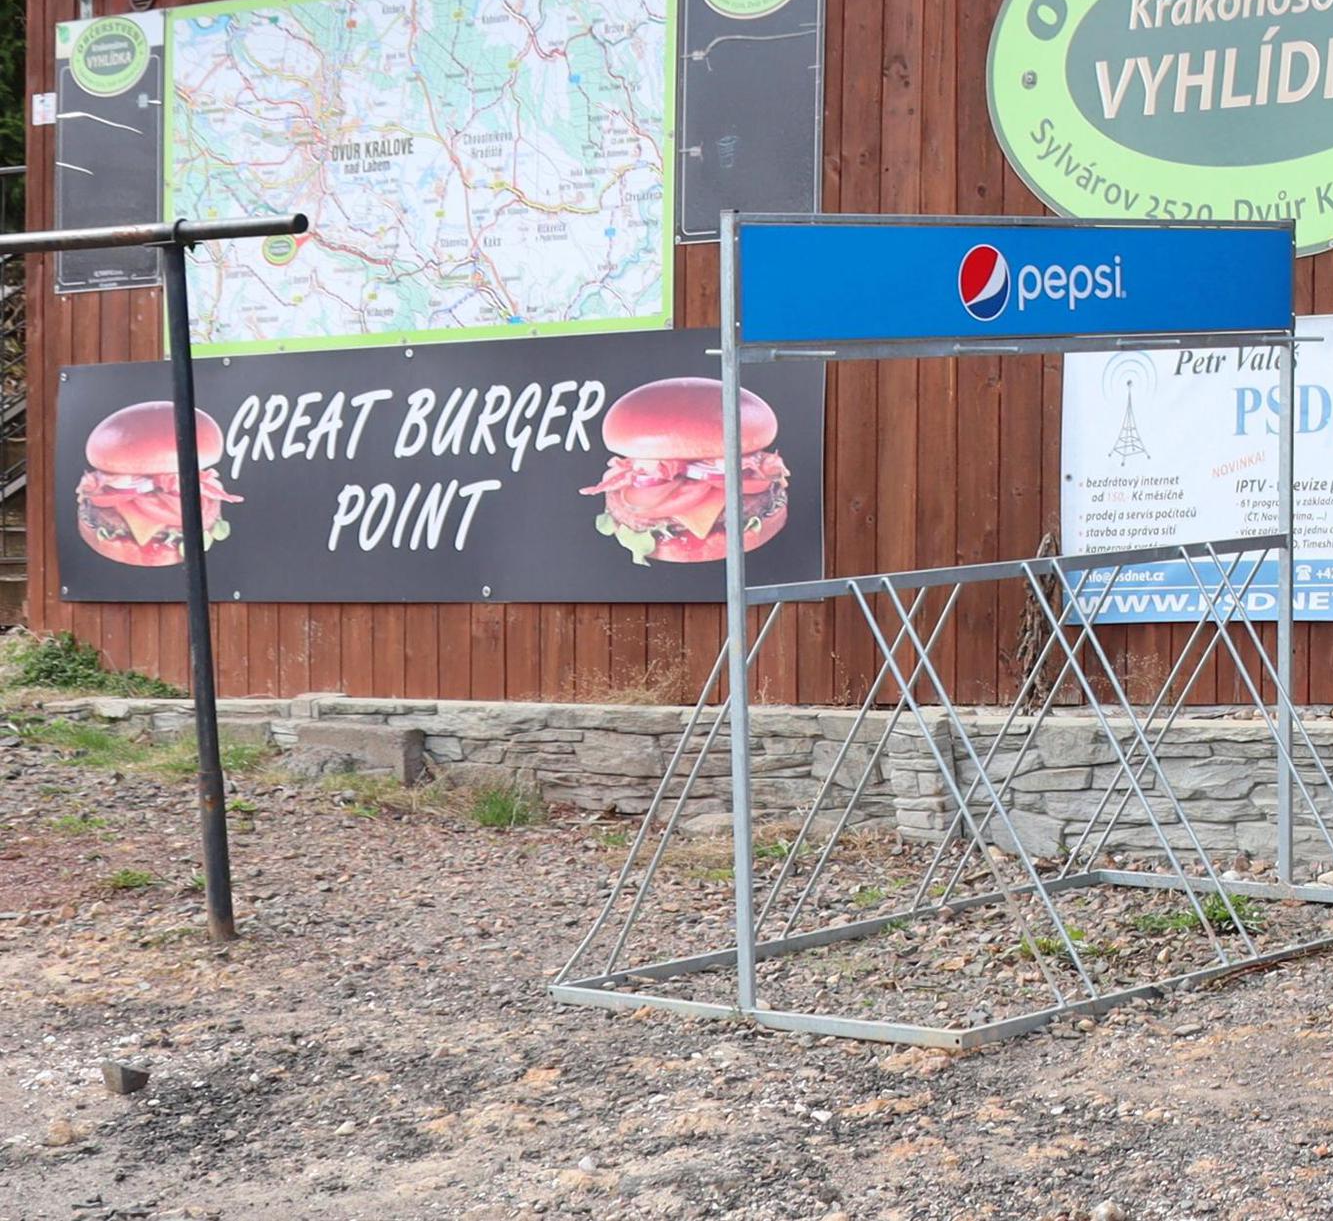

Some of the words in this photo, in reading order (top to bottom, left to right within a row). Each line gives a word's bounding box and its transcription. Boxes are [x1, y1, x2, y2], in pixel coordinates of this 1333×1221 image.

[1030, 118, 1139, 212] Sylvárov
[1234, 191, 1305, 220] Dvůr
[1018, 255, 1124, 311] pepsi
[1174, 350, 1226, 376] Petr
[1233, 384, 1332, 436] PSD
[224, 389, 393, 479] GREAT
[394, 380, 606, 472] BURGER
[1212, 451, 1266, 478] NOVINKA!
[1086, 476, 1140, 489] bezdrátový
[1141, 476, 1179, 486] internet
[1235, 479, 1266, 493] IPTV
[1092, 492, 1104, 502] od
[1131, 491, 1143, 501] Kč
[327, 480, 502, 553] POINT
[1086, 510, 1117, 522] prodej
[1126, 511, 1153, 519] servis
[1086, 527, 1117, 537] stavba
[1127, 527, 1159, 538] správa
[1304, 526, 1328, 536] jednu
[1085, 570, 1164, 583] nfo@sdnet.cz
